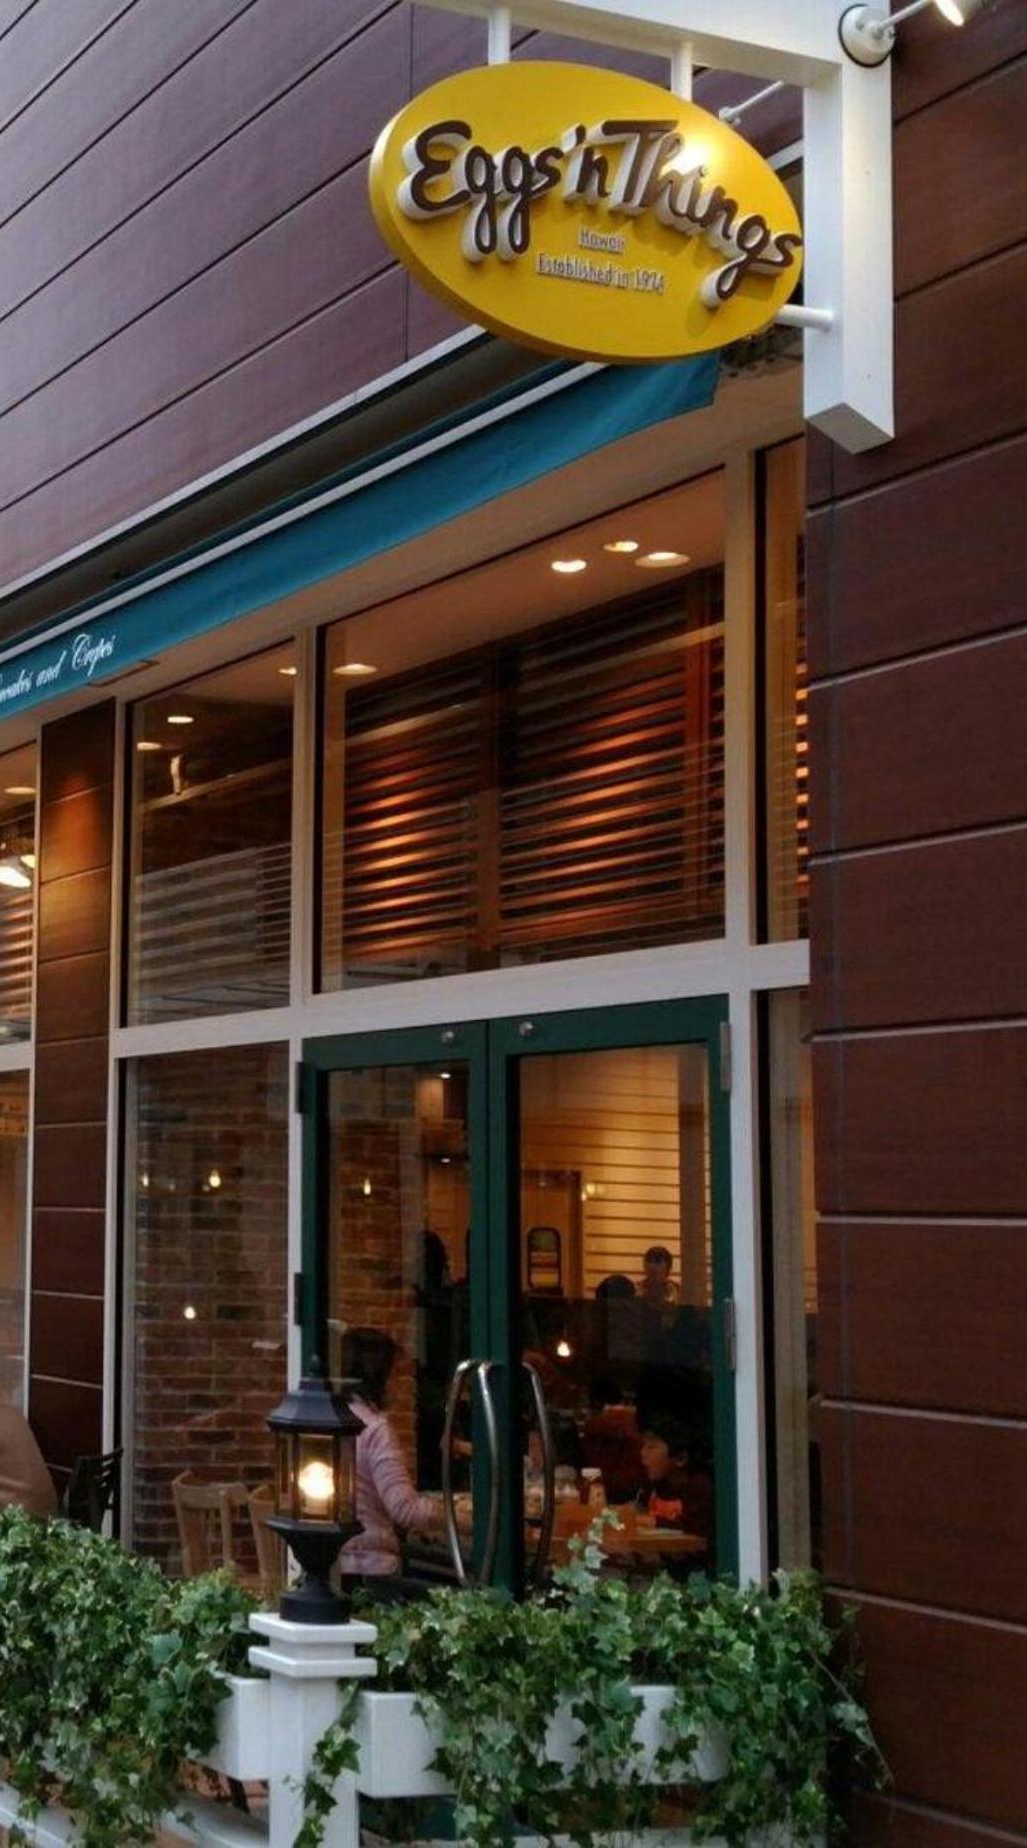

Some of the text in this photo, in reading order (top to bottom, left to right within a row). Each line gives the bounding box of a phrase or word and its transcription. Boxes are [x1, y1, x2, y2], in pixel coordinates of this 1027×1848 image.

[588, 119, 803, 307] Things
[537, 252, 613, 285] Established
[617, 267, 629, 288] in
